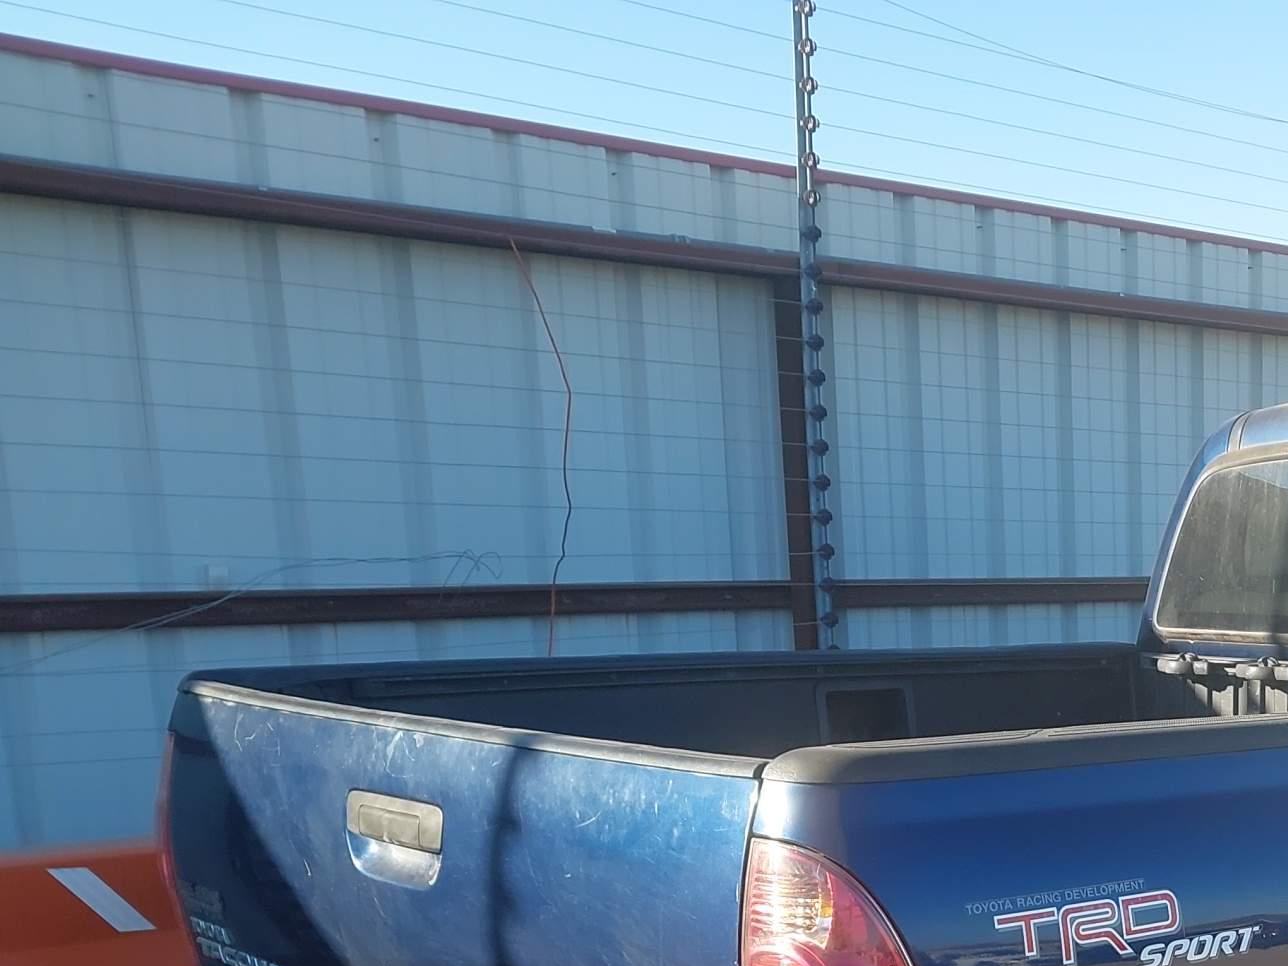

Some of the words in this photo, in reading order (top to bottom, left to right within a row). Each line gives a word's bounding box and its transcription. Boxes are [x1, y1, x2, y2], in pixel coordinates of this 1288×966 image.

[965, 899, 1013, 916] TOYOTA
[1016, 889, 1062, 907] RACING
[1064, 877, 1145, 900] DEVELOPMENT
[993, 889, 1181, 966] TRD
